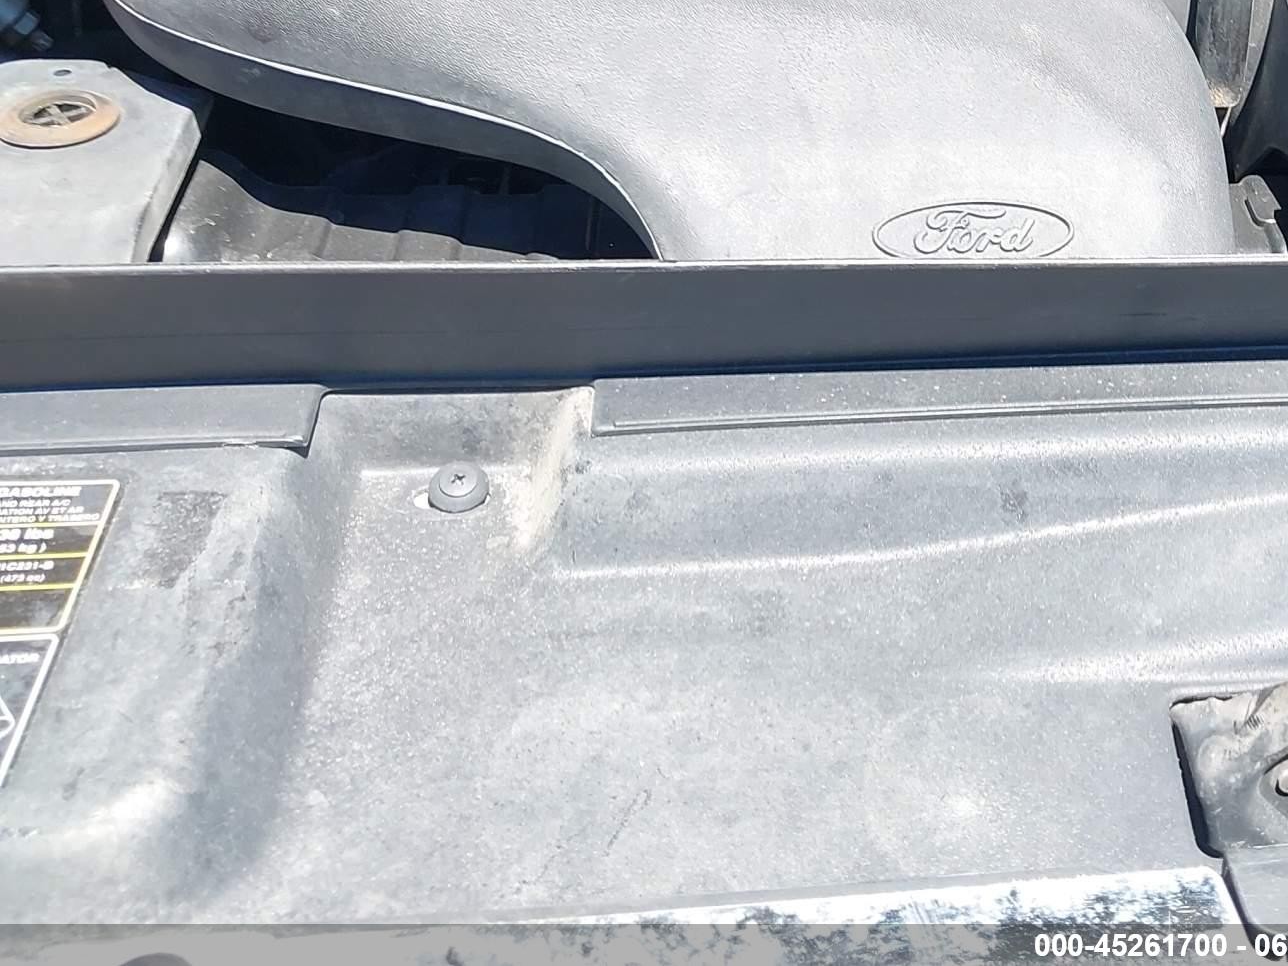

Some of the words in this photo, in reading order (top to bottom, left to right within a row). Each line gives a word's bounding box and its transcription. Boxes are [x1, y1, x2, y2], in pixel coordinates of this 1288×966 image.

[913, 209, 1036, 254] Ford
[19, 498, 51, 507] REAR
[24, 528, 54, 540] lbs
